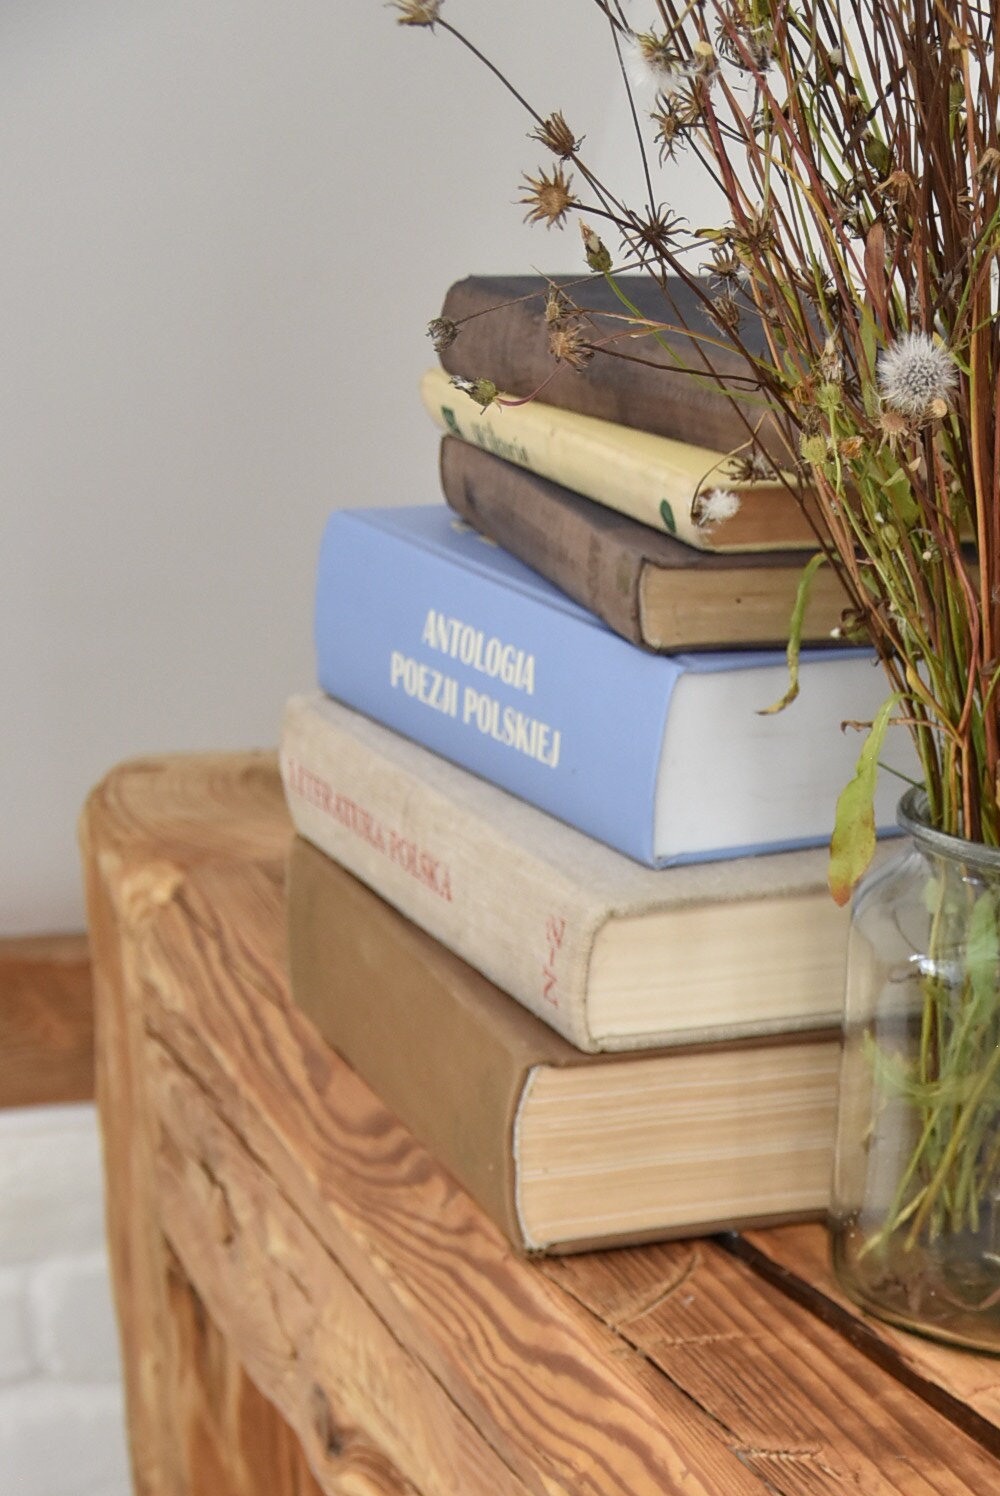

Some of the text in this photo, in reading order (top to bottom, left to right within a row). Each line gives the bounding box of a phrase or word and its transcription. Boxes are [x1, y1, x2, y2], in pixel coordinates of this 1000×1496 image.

[423, 610, 536, 694] ANTOLOGIA
[391, 651, 561, 769] POEZJI POLSKIEJ
[390, 830, 452, 902] POLSKA
